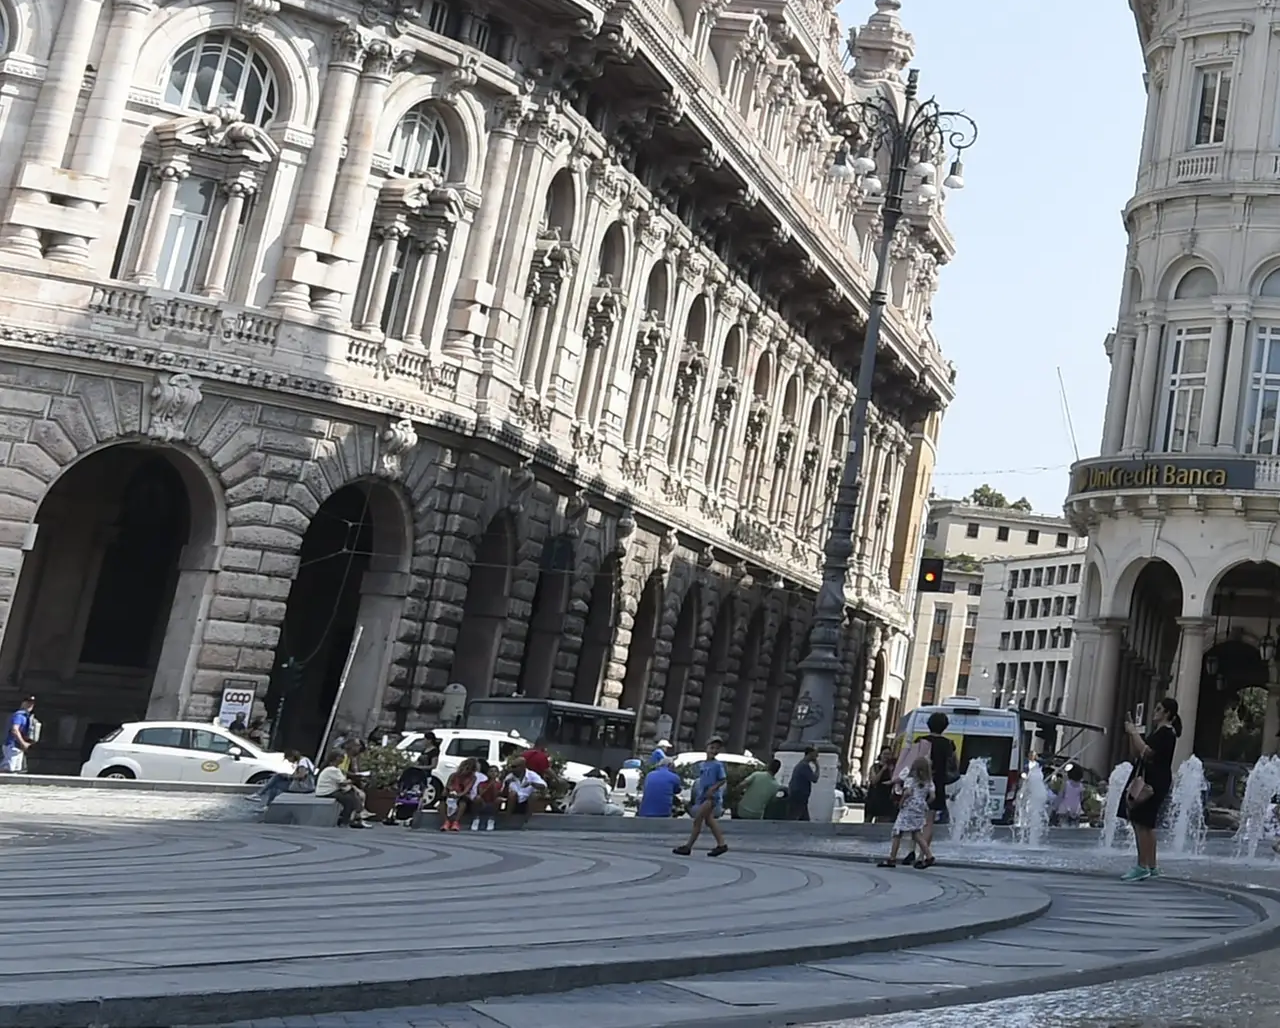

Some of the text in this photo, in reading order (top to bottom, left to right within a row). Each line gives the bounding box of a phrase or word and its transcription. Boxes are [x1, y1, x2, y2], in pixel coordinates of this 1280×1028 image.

[1087, 462, 1227, 489] UniCredit Banca
[224, 691, 252, 707] coop
